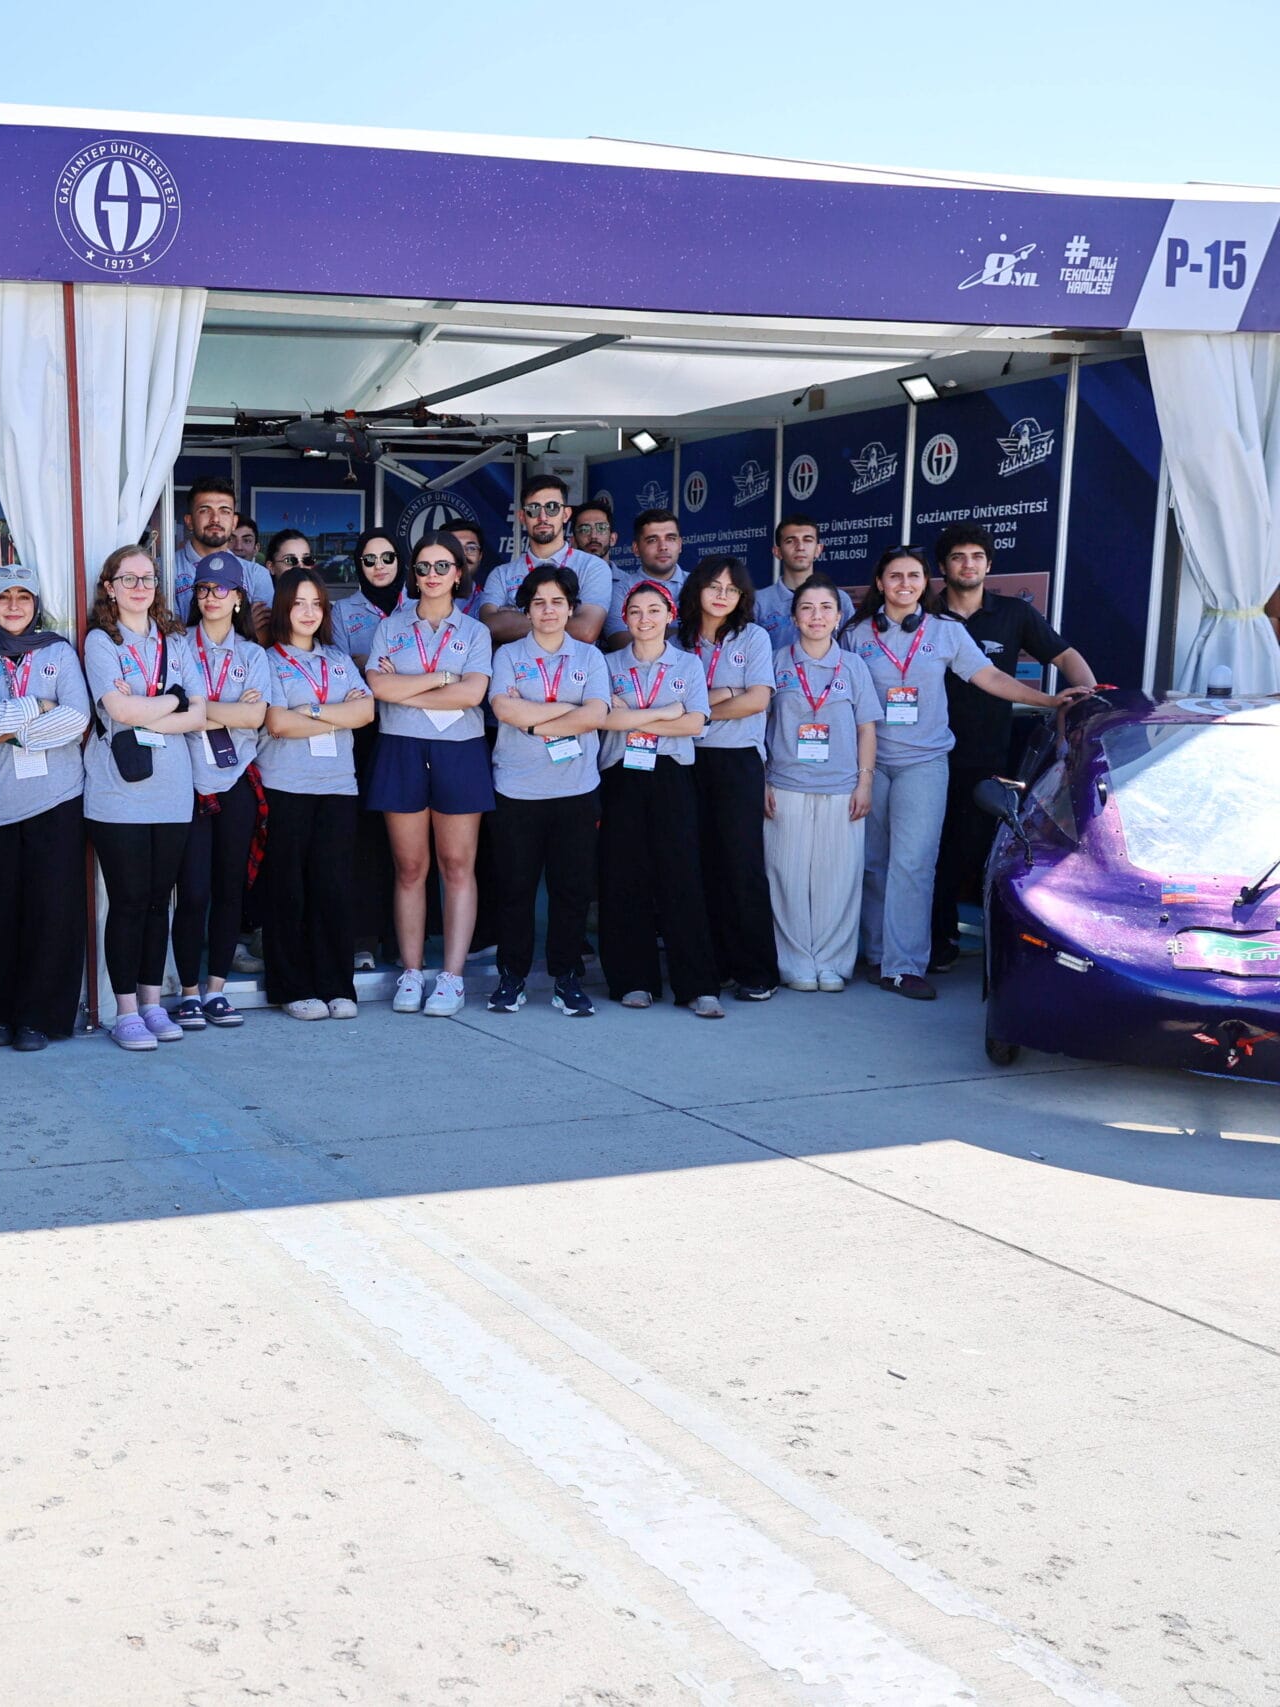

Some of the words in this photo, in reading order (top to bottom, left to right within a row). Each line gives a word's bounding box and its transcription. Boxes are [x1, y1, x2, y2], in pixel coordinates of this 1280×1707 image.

[104, 258, 134, 269] 1973
[1165, 237, 1247, 290] P-15
[916, 509, 970, 525] GAZİANTEP
[972, 498, 1048, 519] ÜNİVERSİTESİ
[994, 521, 1017, 533] 2024
[849, 534, 869, 545] 2023
[829, 549, 867, 562] TABLOSU
